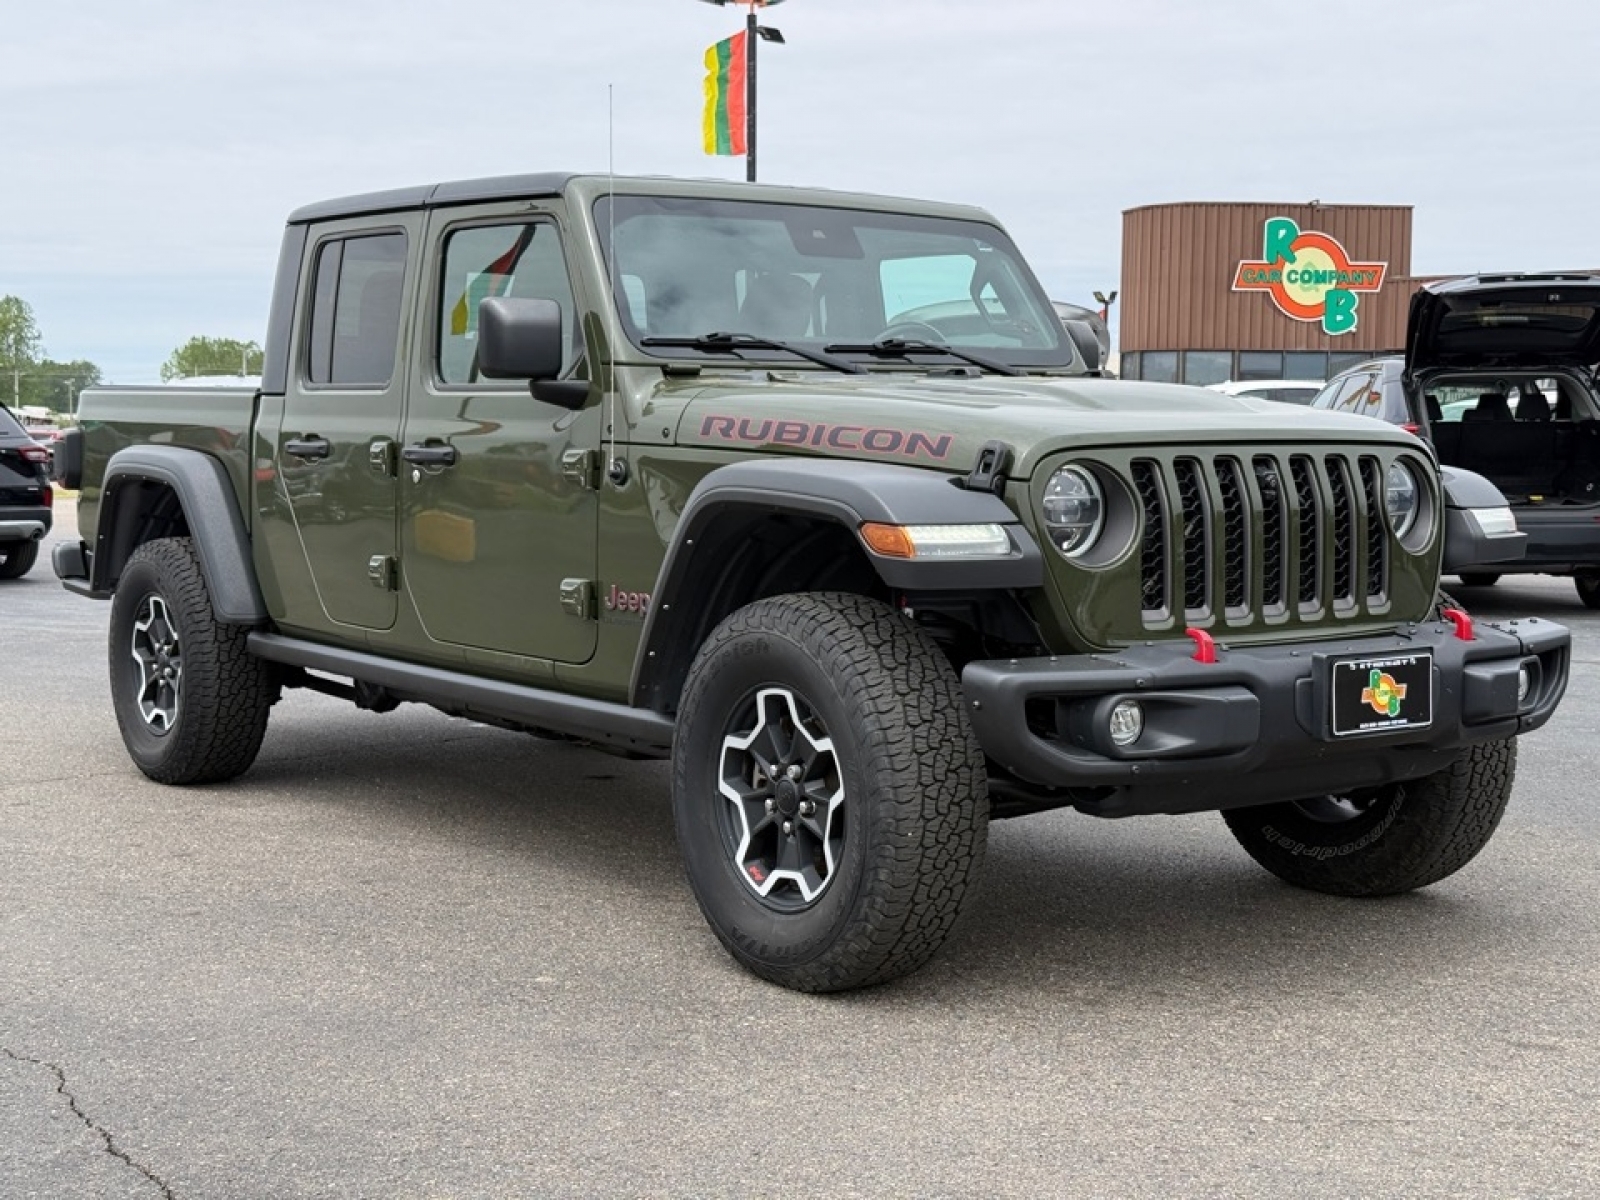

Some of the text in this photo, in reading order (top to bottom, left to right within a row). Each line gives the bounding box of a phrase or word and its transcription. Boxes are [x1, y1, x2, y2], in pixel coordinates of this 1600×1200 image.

[1266, 218, 1299, 263] R
[1241, 269, 1376, 285] CAR COMPANY
[1324, 289, 1358, 334] B
[699, 414, 953, 459] RUBICON
[604, 584, 651, 618] Jeep
